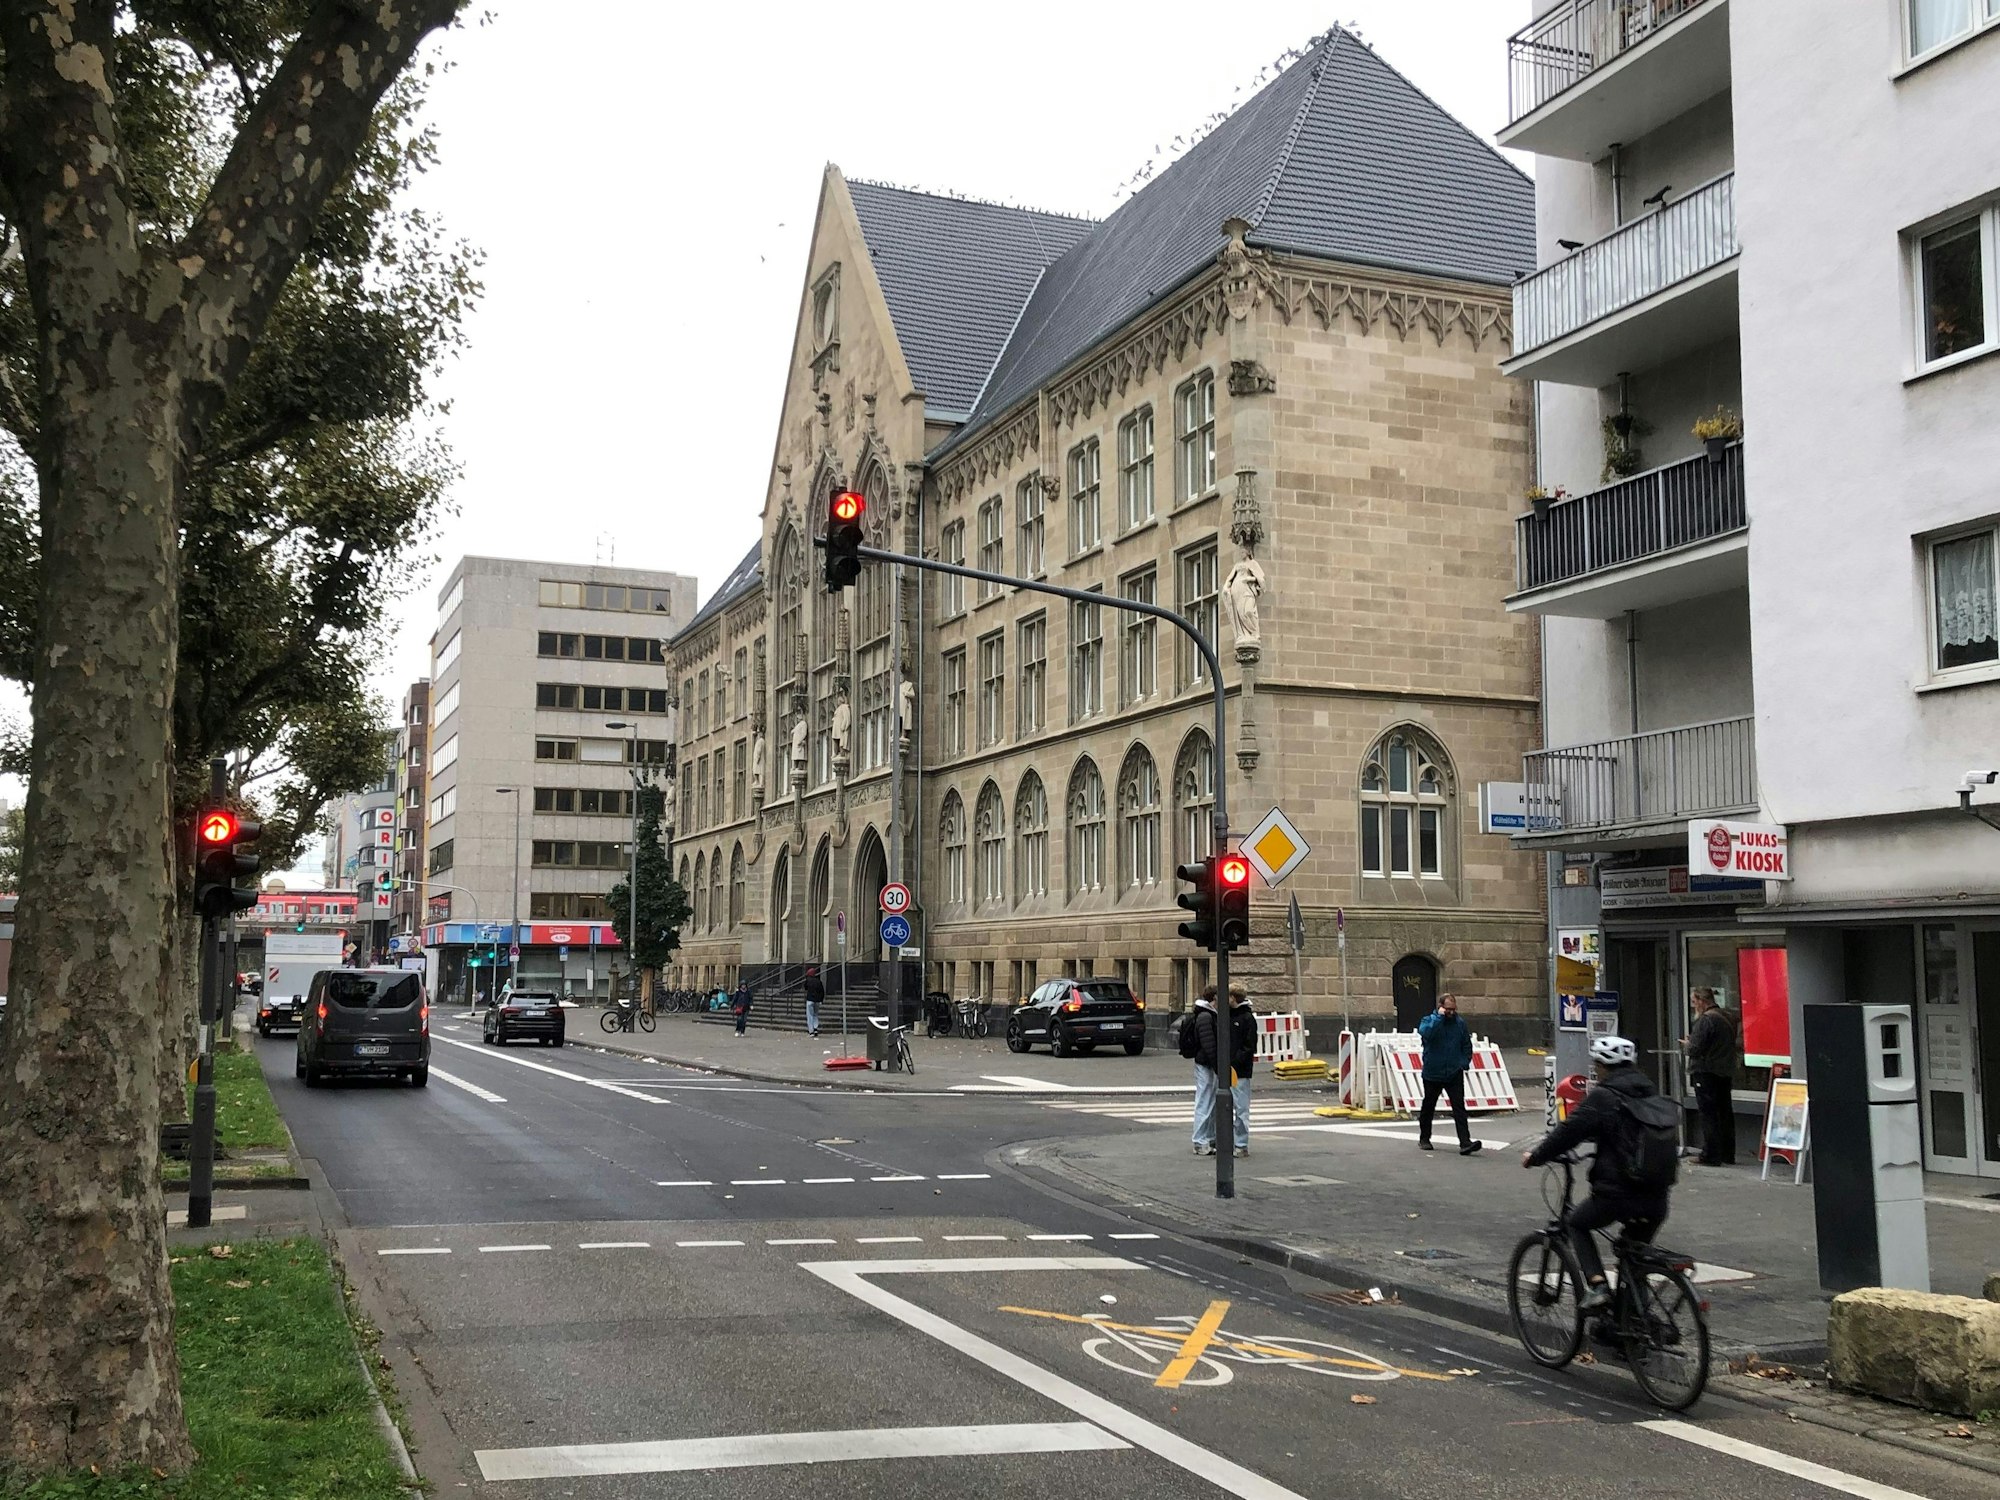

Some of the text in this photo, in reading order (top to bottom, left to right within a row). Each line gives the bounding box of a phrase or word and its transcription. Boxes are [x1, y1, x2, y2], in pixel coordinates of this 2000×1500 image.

[1740, 832, 1777, 848] LUKAS
[1736, 850, 1784, 873] KIOSK
[886, 891, 904, 906] 30
